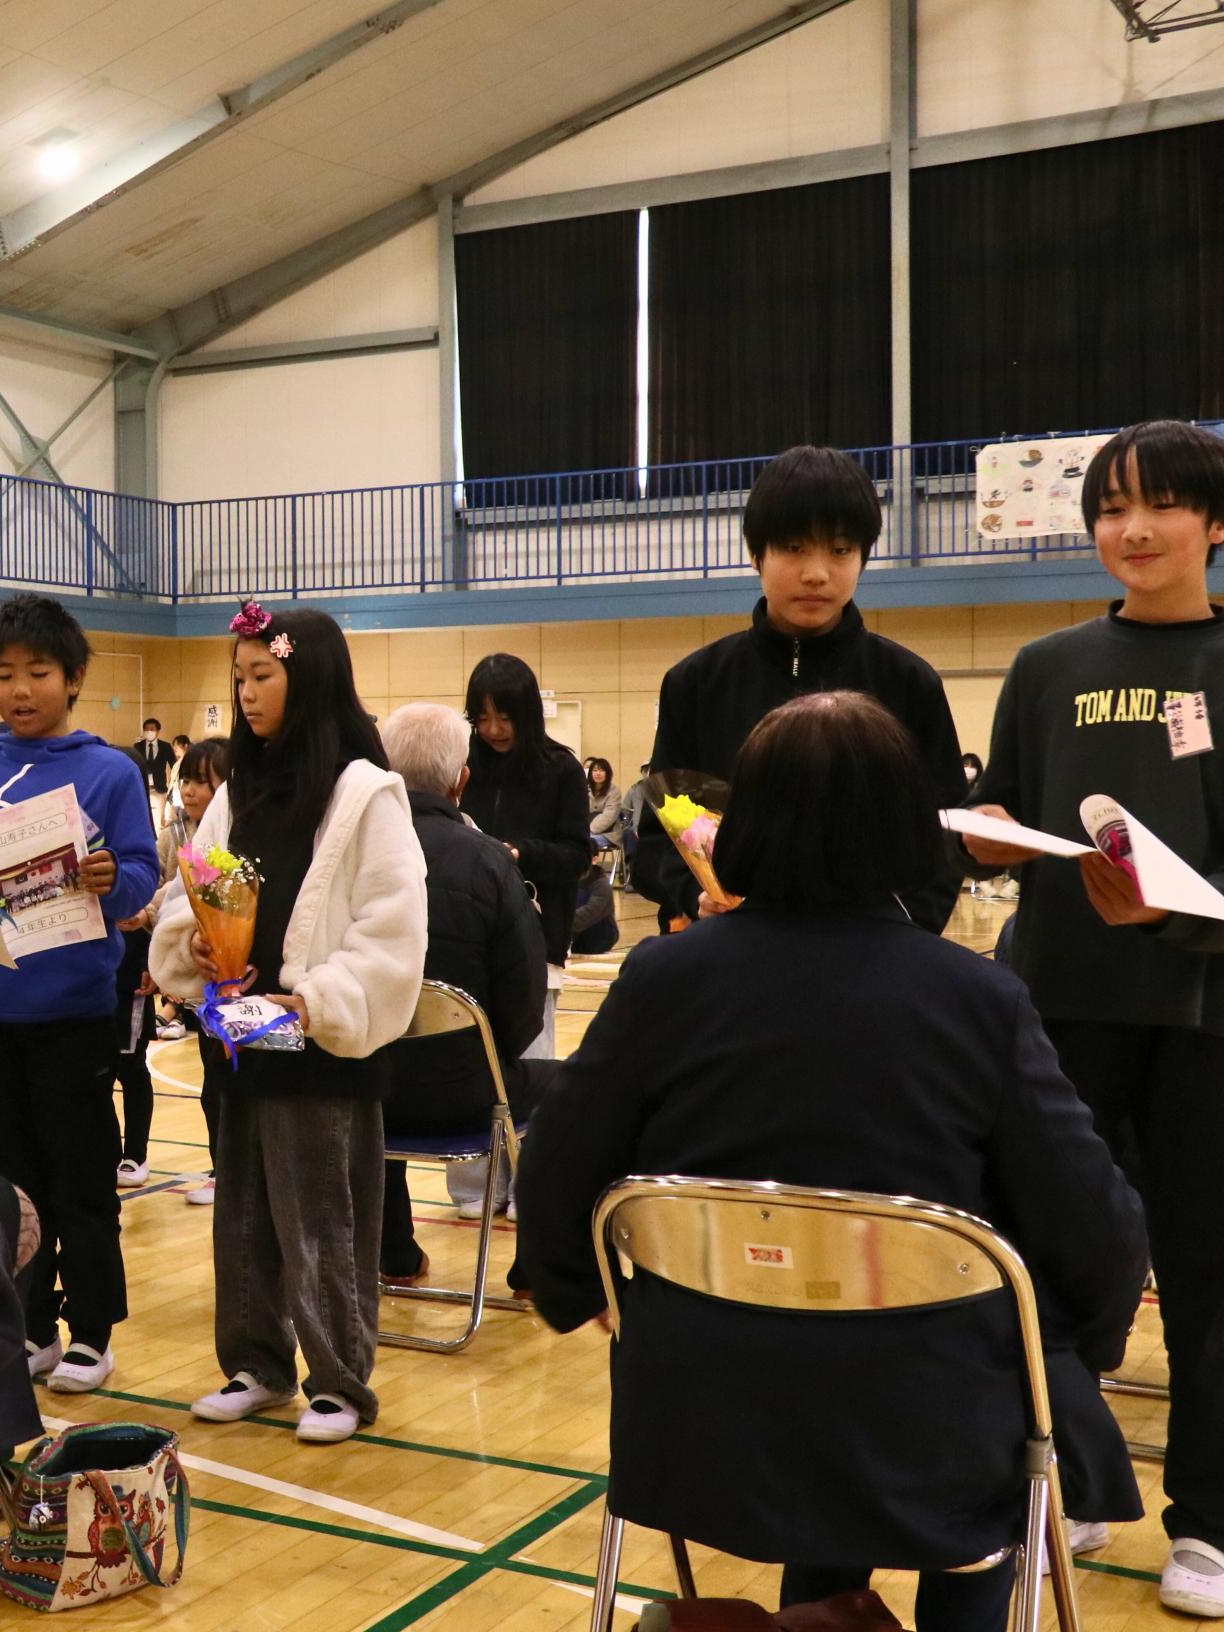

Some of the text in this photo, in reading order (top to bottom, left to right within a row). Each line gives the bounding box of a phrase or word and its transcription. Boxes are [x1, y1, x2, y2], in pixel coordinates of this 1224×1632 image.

[207, 705, 218, 728] 感謝
[1074, 689, 1114, 727] TOM
[1114, 688, 1157, 722] AND
